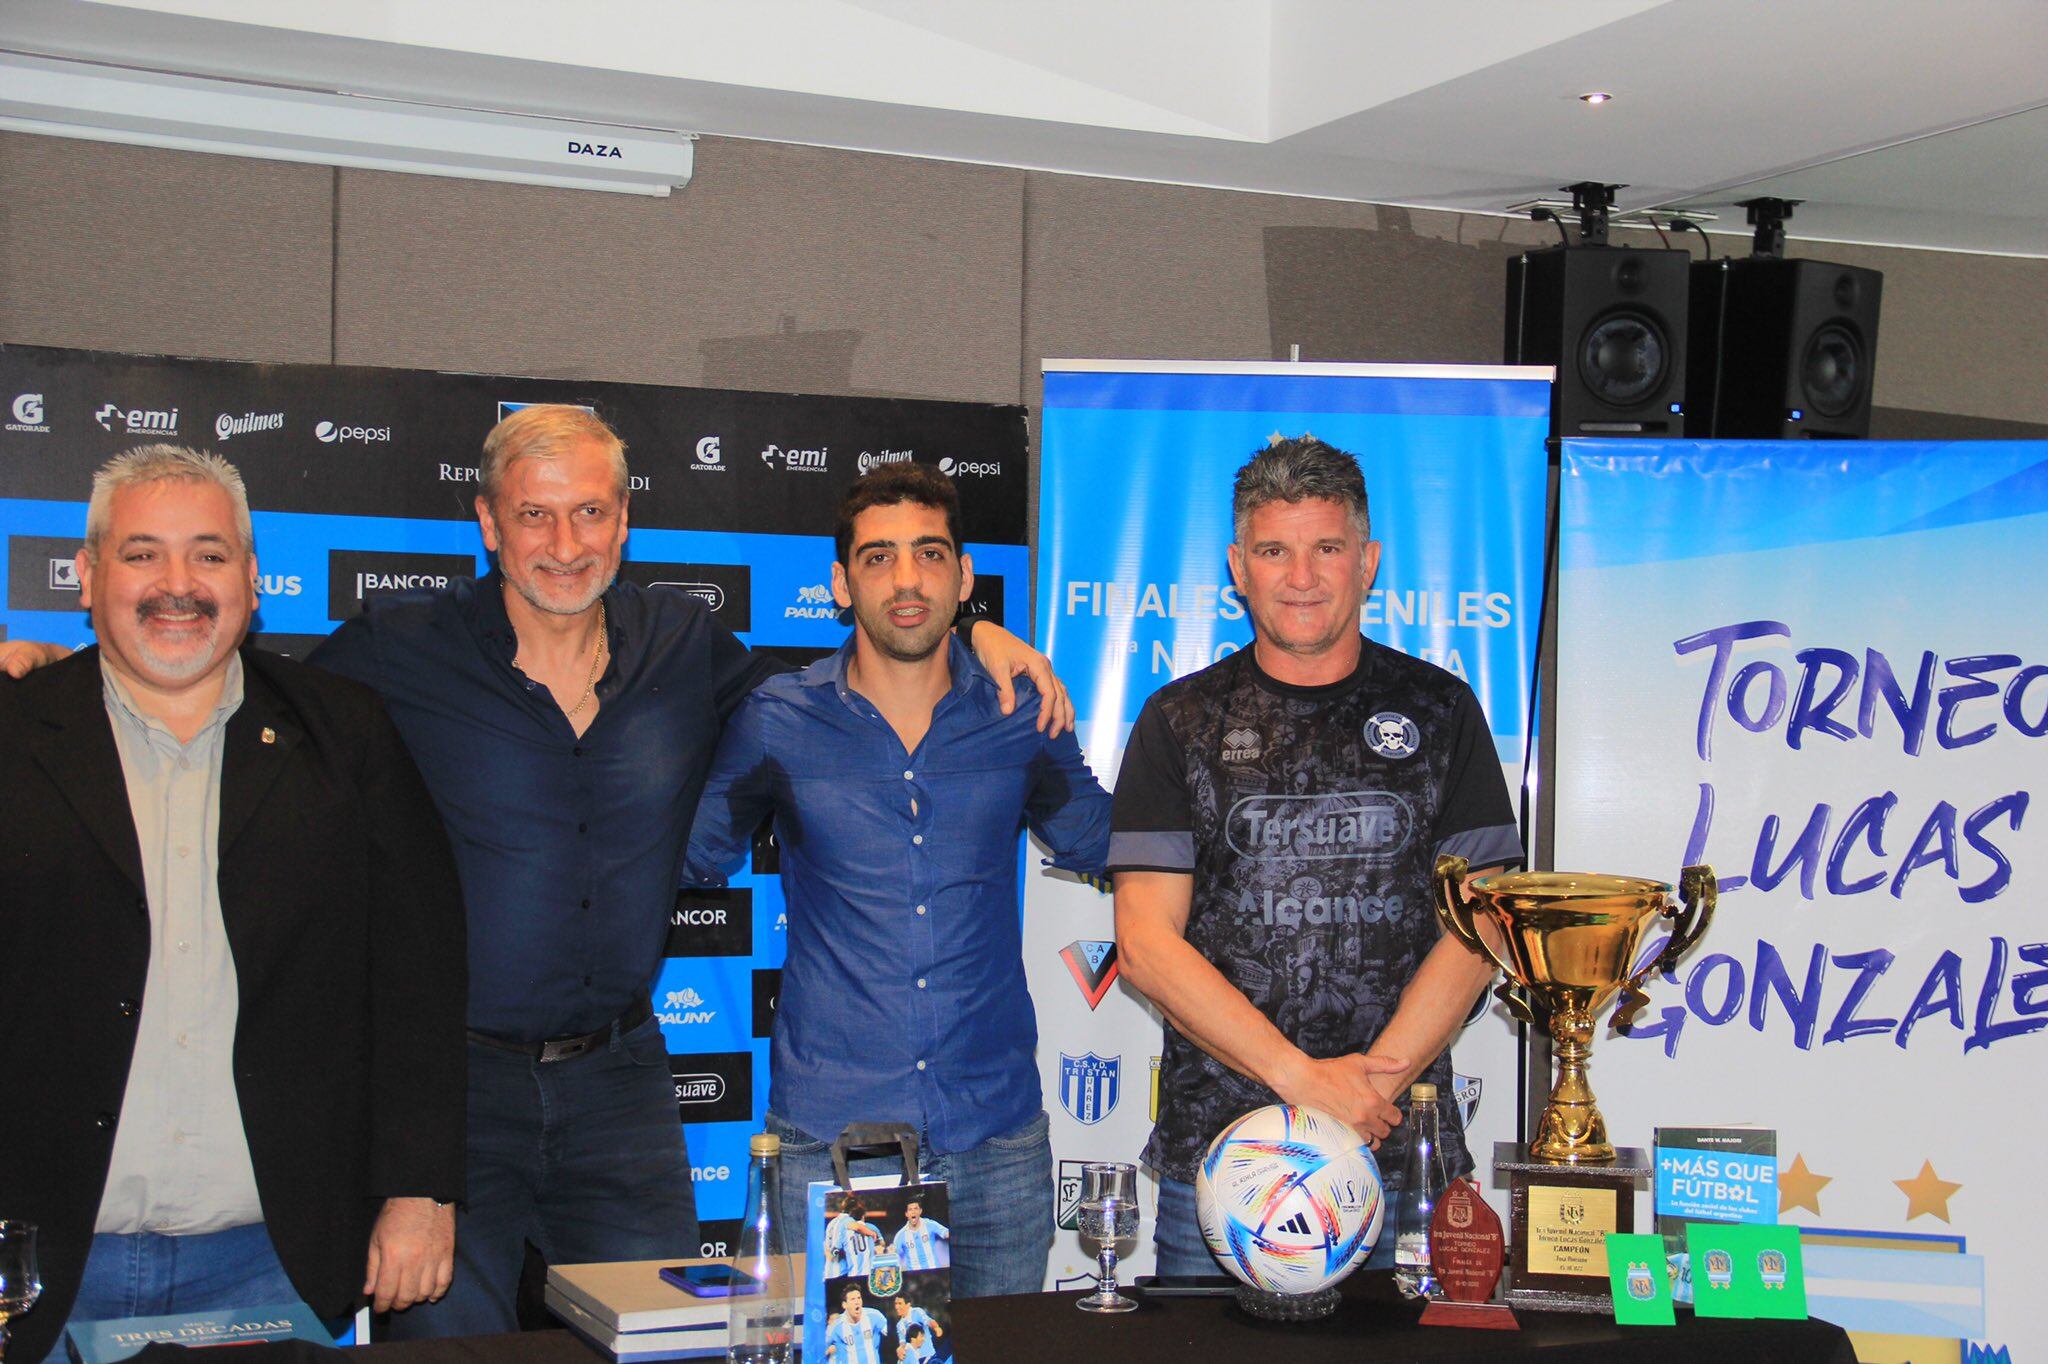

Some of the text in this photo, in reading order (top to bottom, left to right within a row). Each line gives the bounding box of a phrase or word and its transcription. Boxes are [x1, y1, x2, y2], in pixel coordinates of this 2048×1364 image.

[568, 141, 622, 158] DAZA
[127, 408, 178, 429] emi
[214, 411, 284, 441] Quilmes
[5, 424, 50, 432] GATORADE
[126, 428, 178, 436] EMERGENCIAS
[340, 426, 390, 444] pepsi
[786, 447, 828, 467] emi
[690, 464, 726, 472] GATORADE
[958, 461, 1001, 478] pepsi
[627, 476, 650, 490] DI
[253, 575, 302, 596] RUS
[364, 573, 449, 590] BANCOR
[1066, 581, 1512, 628] FINALES ENILES
[1673, 620, 2048, 762] TORNEO
[1242, 808, 1396, 846] Tersuave
[1678, 783, 2030, 904] LUCAS
[1233, 889, 1404, 926] Alcance
[671, 909, 727, 925] NCOR
[1065, 1067, 1115, 1078] TRISTAN
[675, 1083, 717, 1098] suave
[1455, 1087, 1477, 1102] GRO
[690, 1165, 730, 1181] nce
[1725, 1162, 1774, 1183] QUE
[700, 1241, 727, 1258] OR
[113, 1330, 174, 1343] TRES
